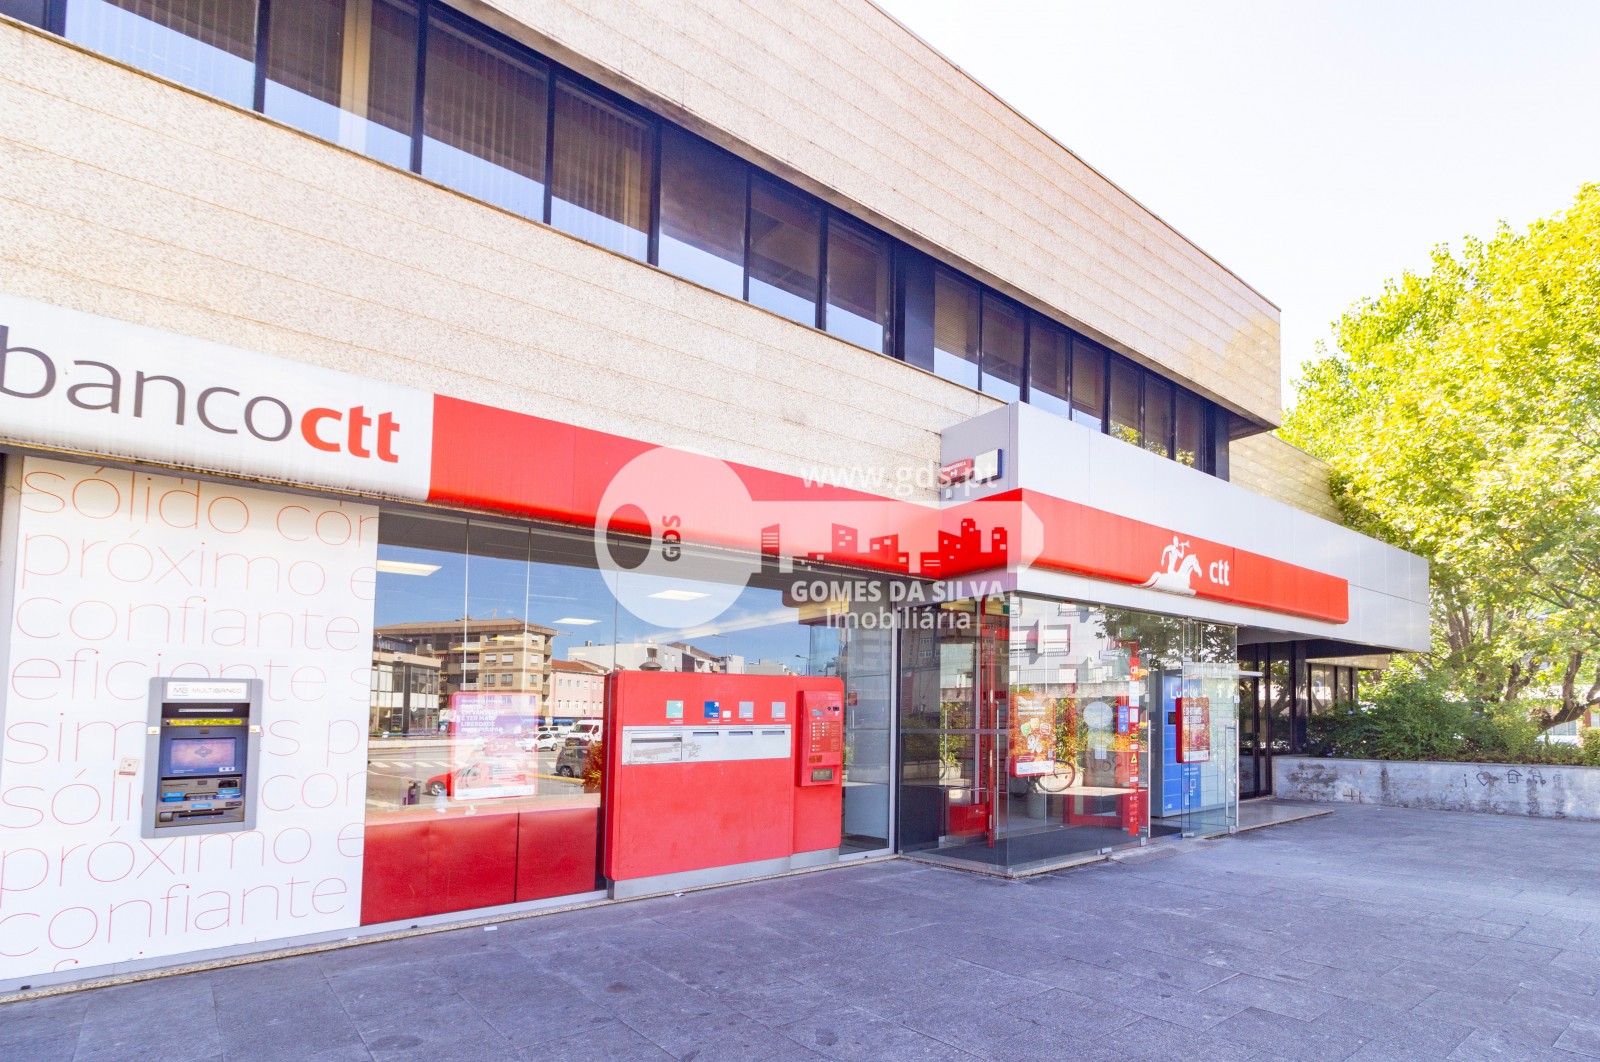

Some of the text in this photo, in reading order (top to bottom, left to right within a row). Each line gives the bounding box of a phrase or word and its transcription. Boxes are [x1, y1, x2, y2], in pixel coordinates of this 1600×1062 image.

[22, 467, 250, 533] sólido
[22, 530, 326, 597] próximo
[1209, 559, 1230, 587] ctt
[16, 596, 360, 652] confiante
[0, 826, 312, 909] próximo
[0, 877, 348, 956] confiante
